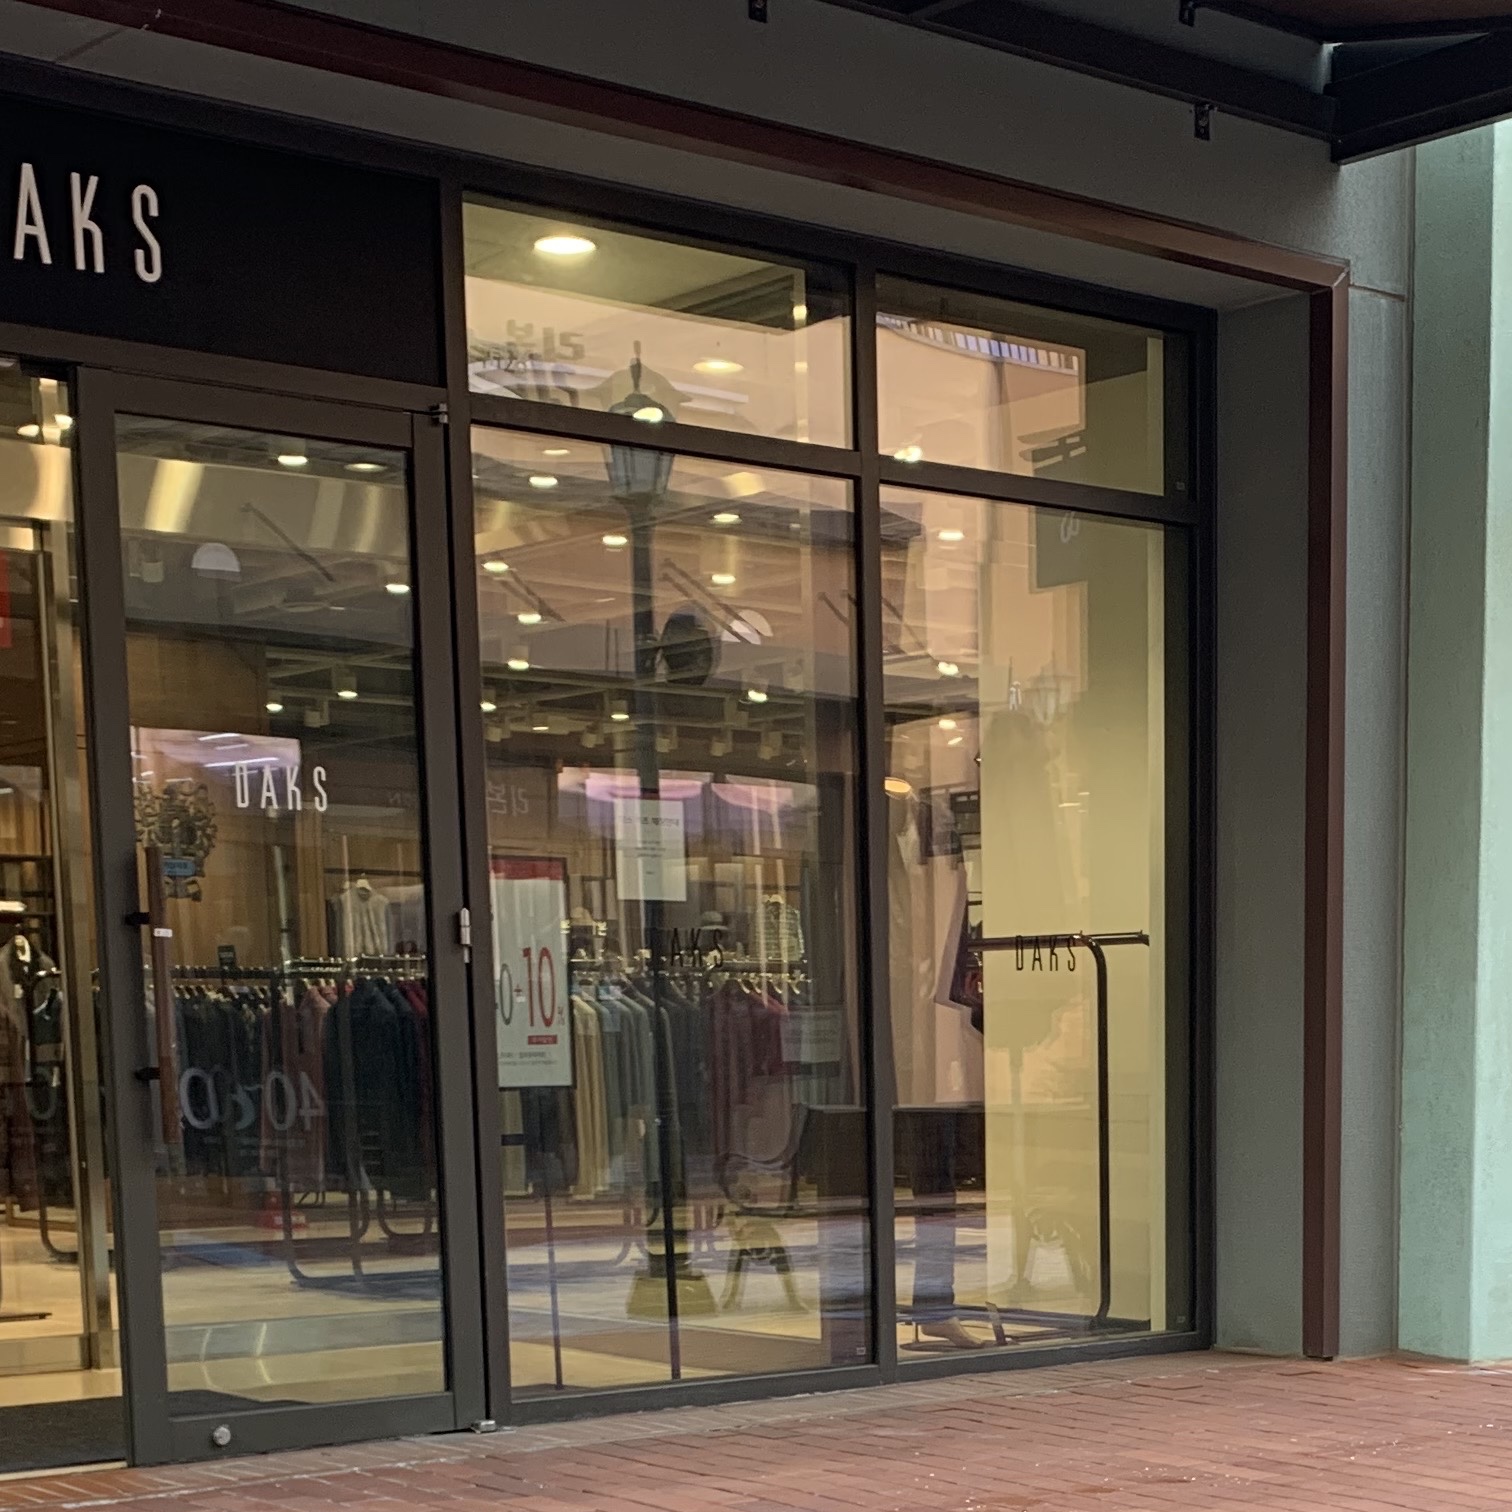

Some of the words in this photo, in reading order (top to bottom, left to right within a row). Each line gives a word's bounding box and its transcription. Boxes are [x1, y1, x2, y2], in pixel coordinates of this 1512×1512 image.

[235, 761, 328, 812] DAKS
[653, 927, 724, 969] AKS
[1015, 934, 1076, 972] DAKS
